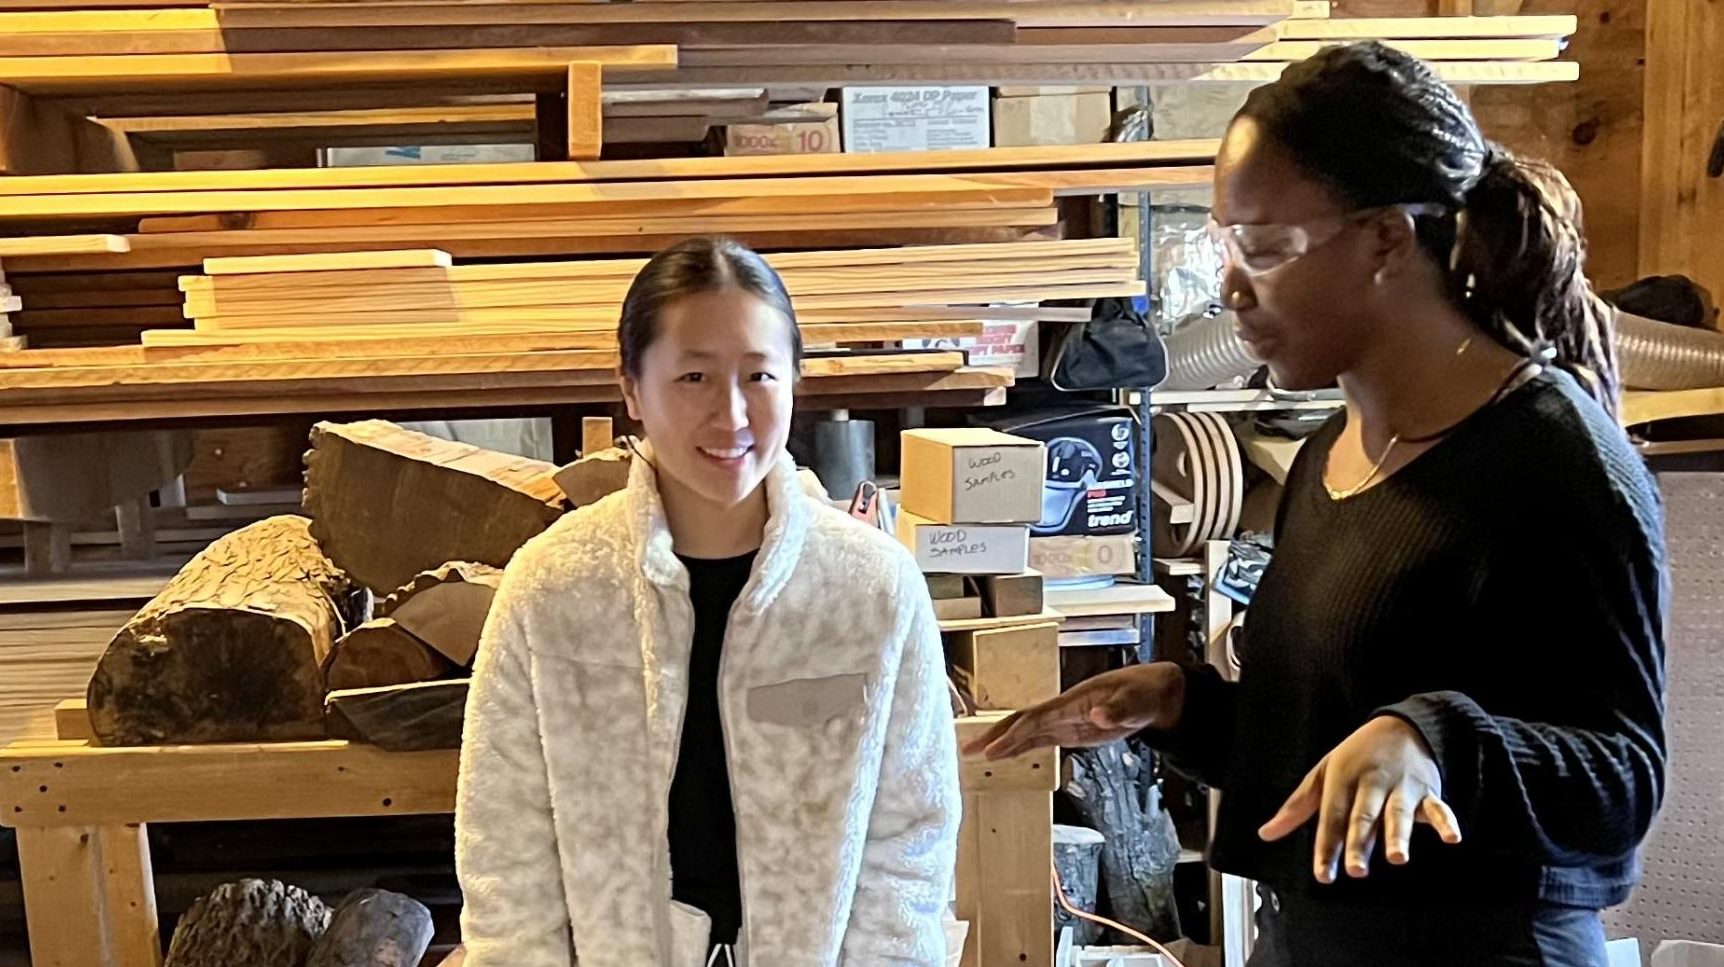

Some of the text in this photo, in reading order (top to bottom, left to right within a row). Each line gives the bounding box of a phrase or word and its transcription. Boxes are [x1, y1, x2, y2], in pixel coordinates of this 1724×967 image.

[923, 90, 941, 101] DP
[796, 130, 823, 152] 10
[968, 452, 1002, 469] WOOD
[1087, 510, 1134, 528] trend
[929, 530, 967, 545] WOOD
